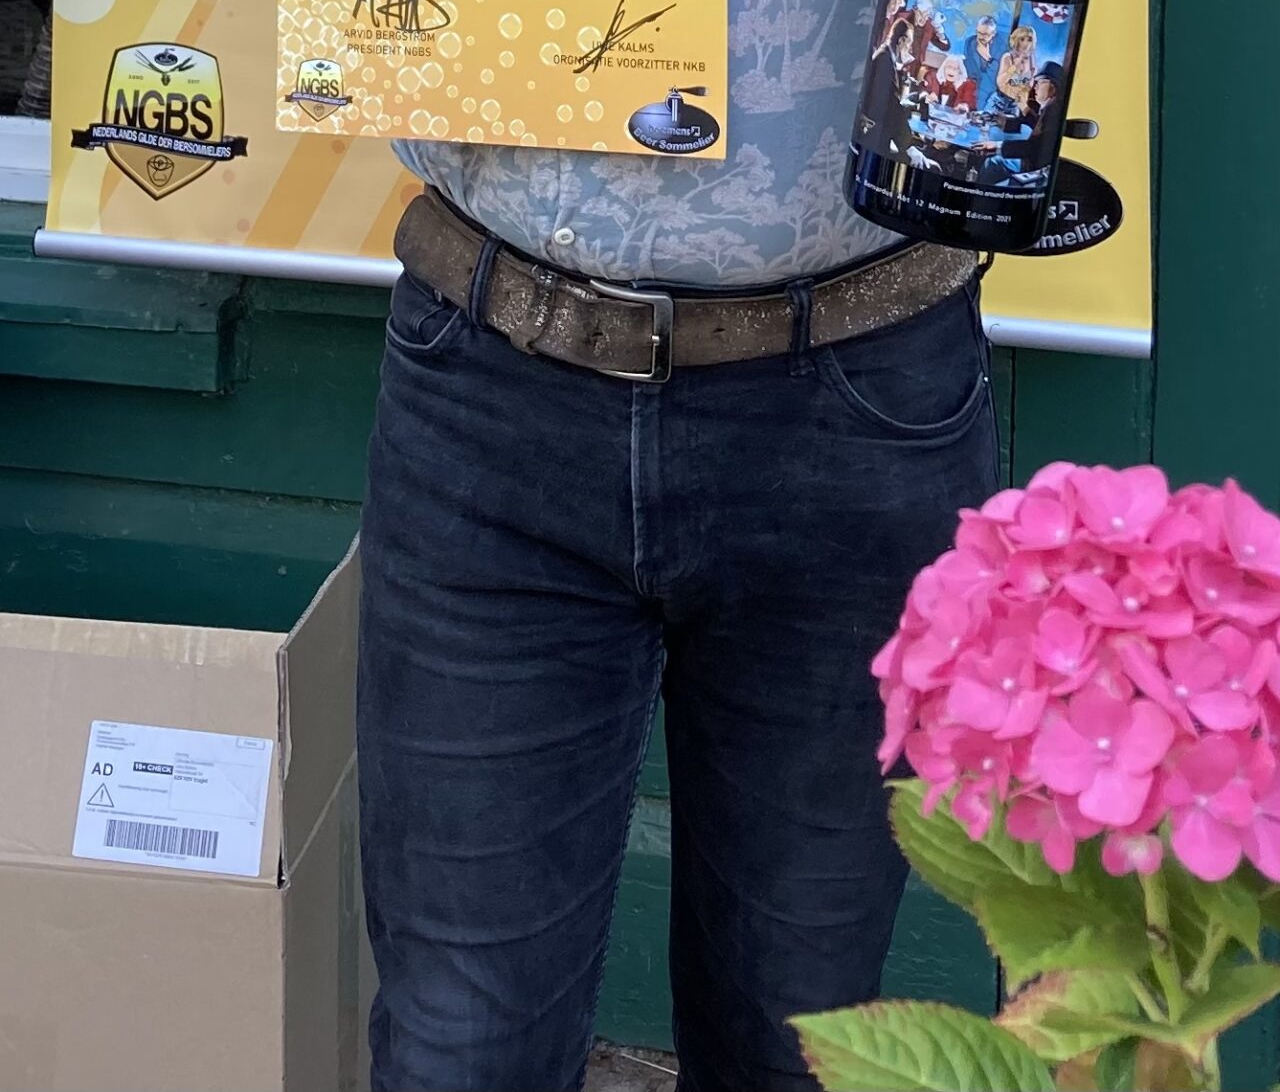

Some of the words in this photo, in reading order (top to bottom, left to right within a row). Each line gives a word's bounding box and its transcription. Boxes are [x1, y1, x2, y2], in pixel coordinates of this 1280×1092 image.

[344, 28, 373, 40] ARVID
[347, 43, 402, 56] PRESIDENT
[404, 46, 431, 57] NGBS
[618, 42, 655, 54] KALMS
[617, 58, 680, 70] VOORZITTER
[683, 61, 706, 72] NKB
[300, 78, 340, 98] NGBS
[113, 88, 214, 140] NGBS
[92, 126, 137, 142] NEDERLANDS
[138, 132, 158, 147] GILDE
[158, 136, 173, 148] DER
[173, 139, 232, 158] BIERSOMMELIERS
[928, 202, 961, 216] Magnum
[966, 210, 993, 221] Edition
[91, 761, 114, 776] AD
